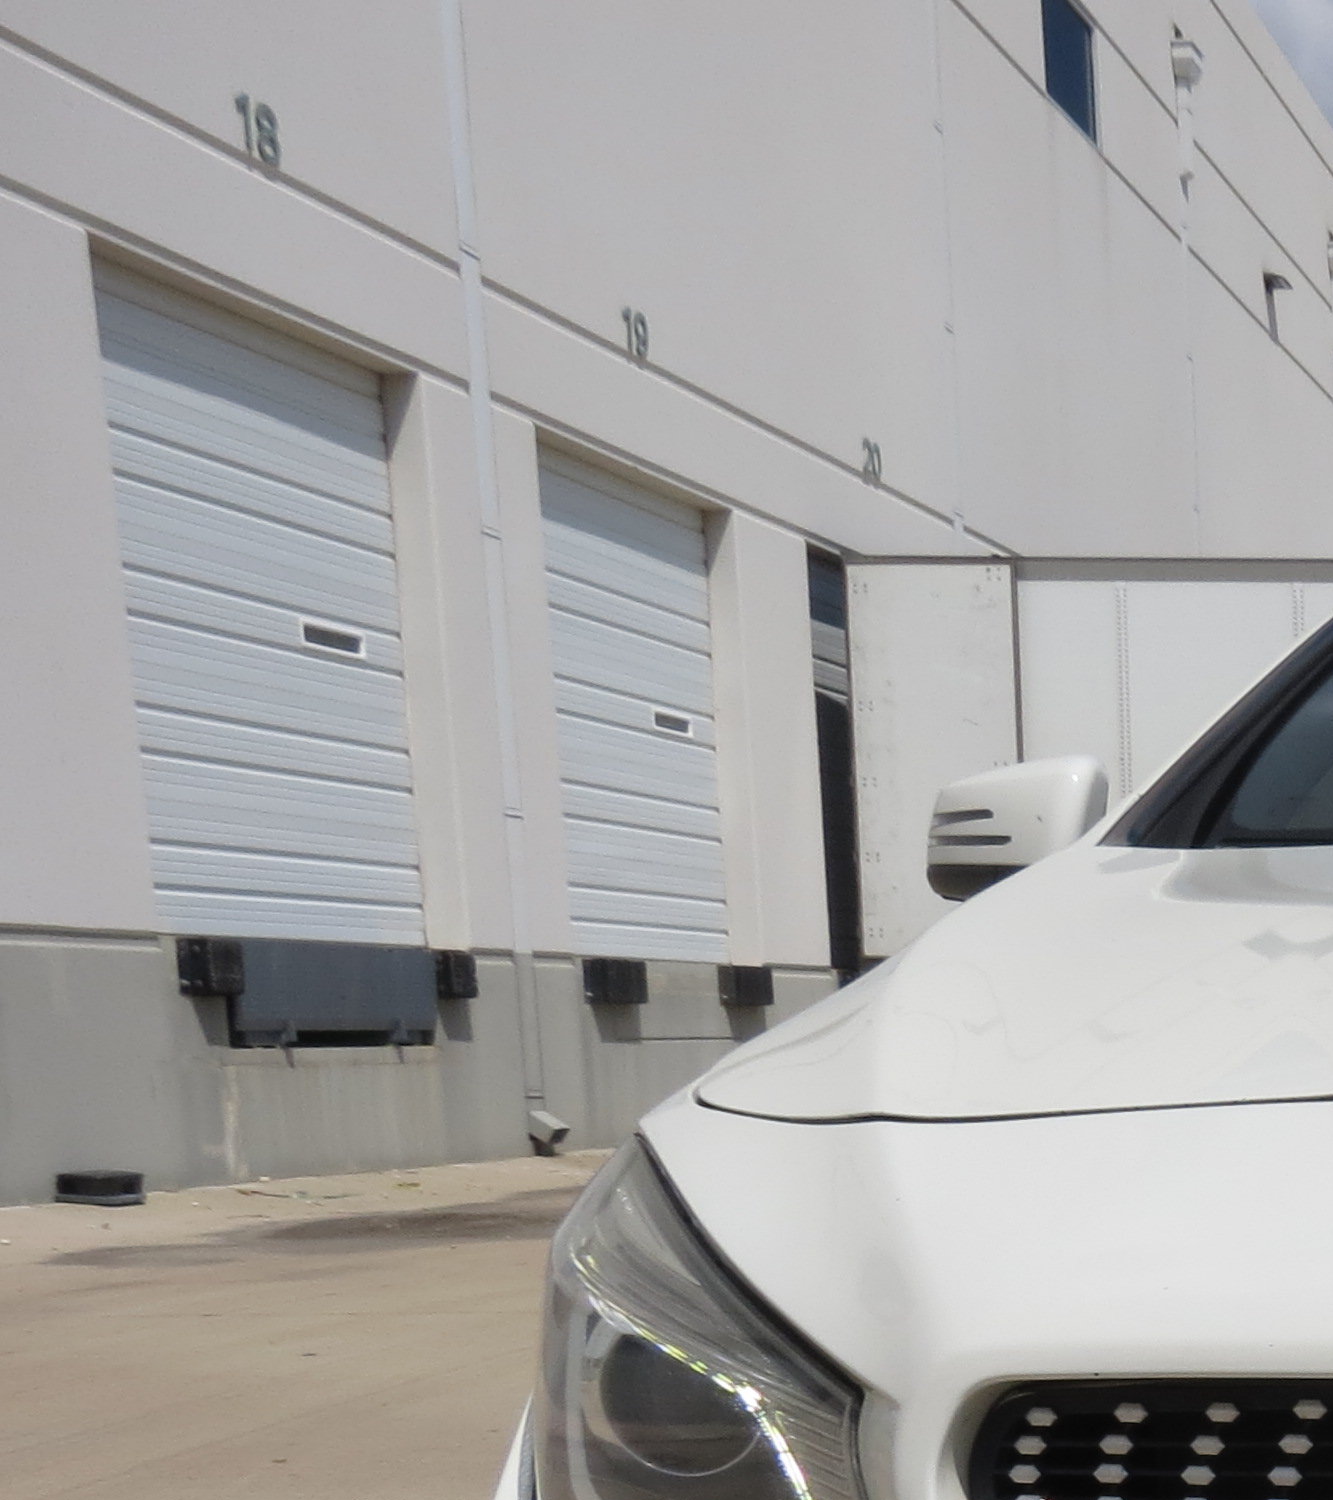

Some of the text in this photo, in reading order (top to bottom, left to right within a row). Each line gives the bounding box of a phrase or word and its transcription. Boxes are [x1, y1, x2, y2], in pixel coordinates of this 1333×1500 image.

[233, 93, 281, 167] 18
[621, 306, 649, 358] 19
[862, 438, 881, 481] 20
